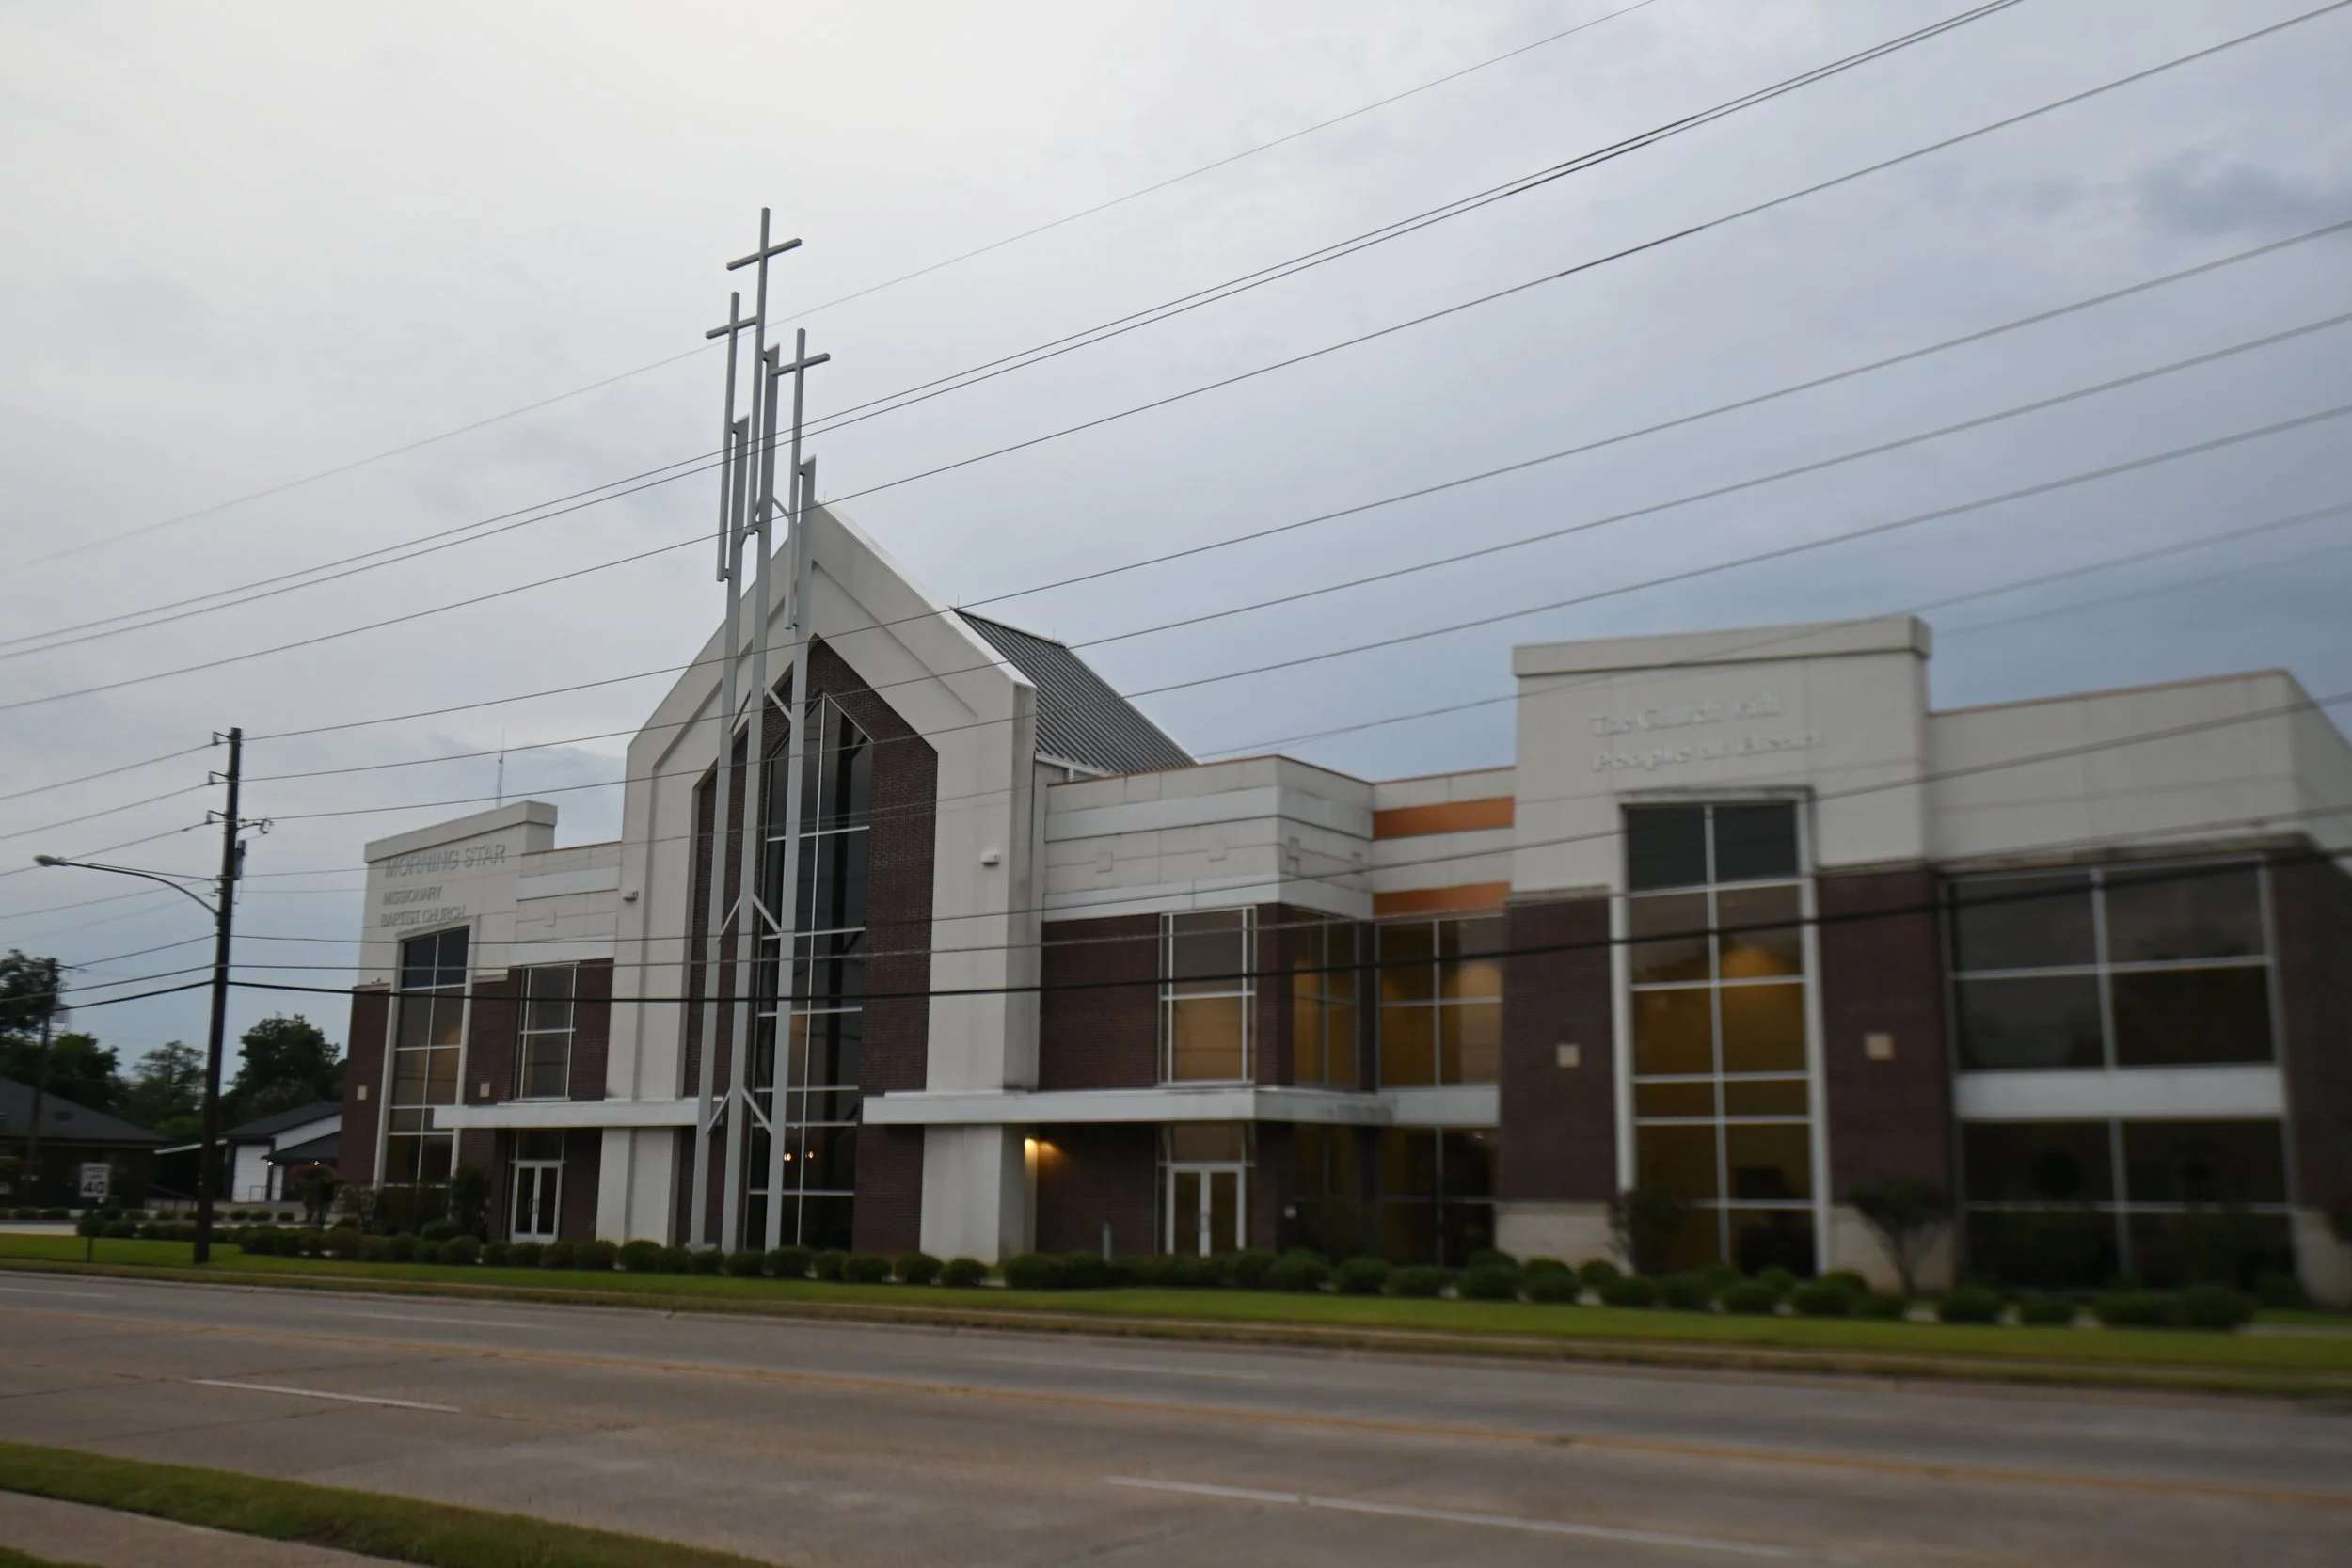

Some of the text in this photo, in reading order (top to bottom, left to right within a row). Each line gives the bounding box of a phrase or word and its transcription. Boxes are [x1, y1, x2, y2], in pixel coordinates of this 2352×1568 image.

[1592, 742, 1691, 772] People
[385, 843, 506, 878] MORNING STAR
[382, 885, 443, 906] MISSIONARY
[380, 904, 467, 927] BAPTIST CHURCH
